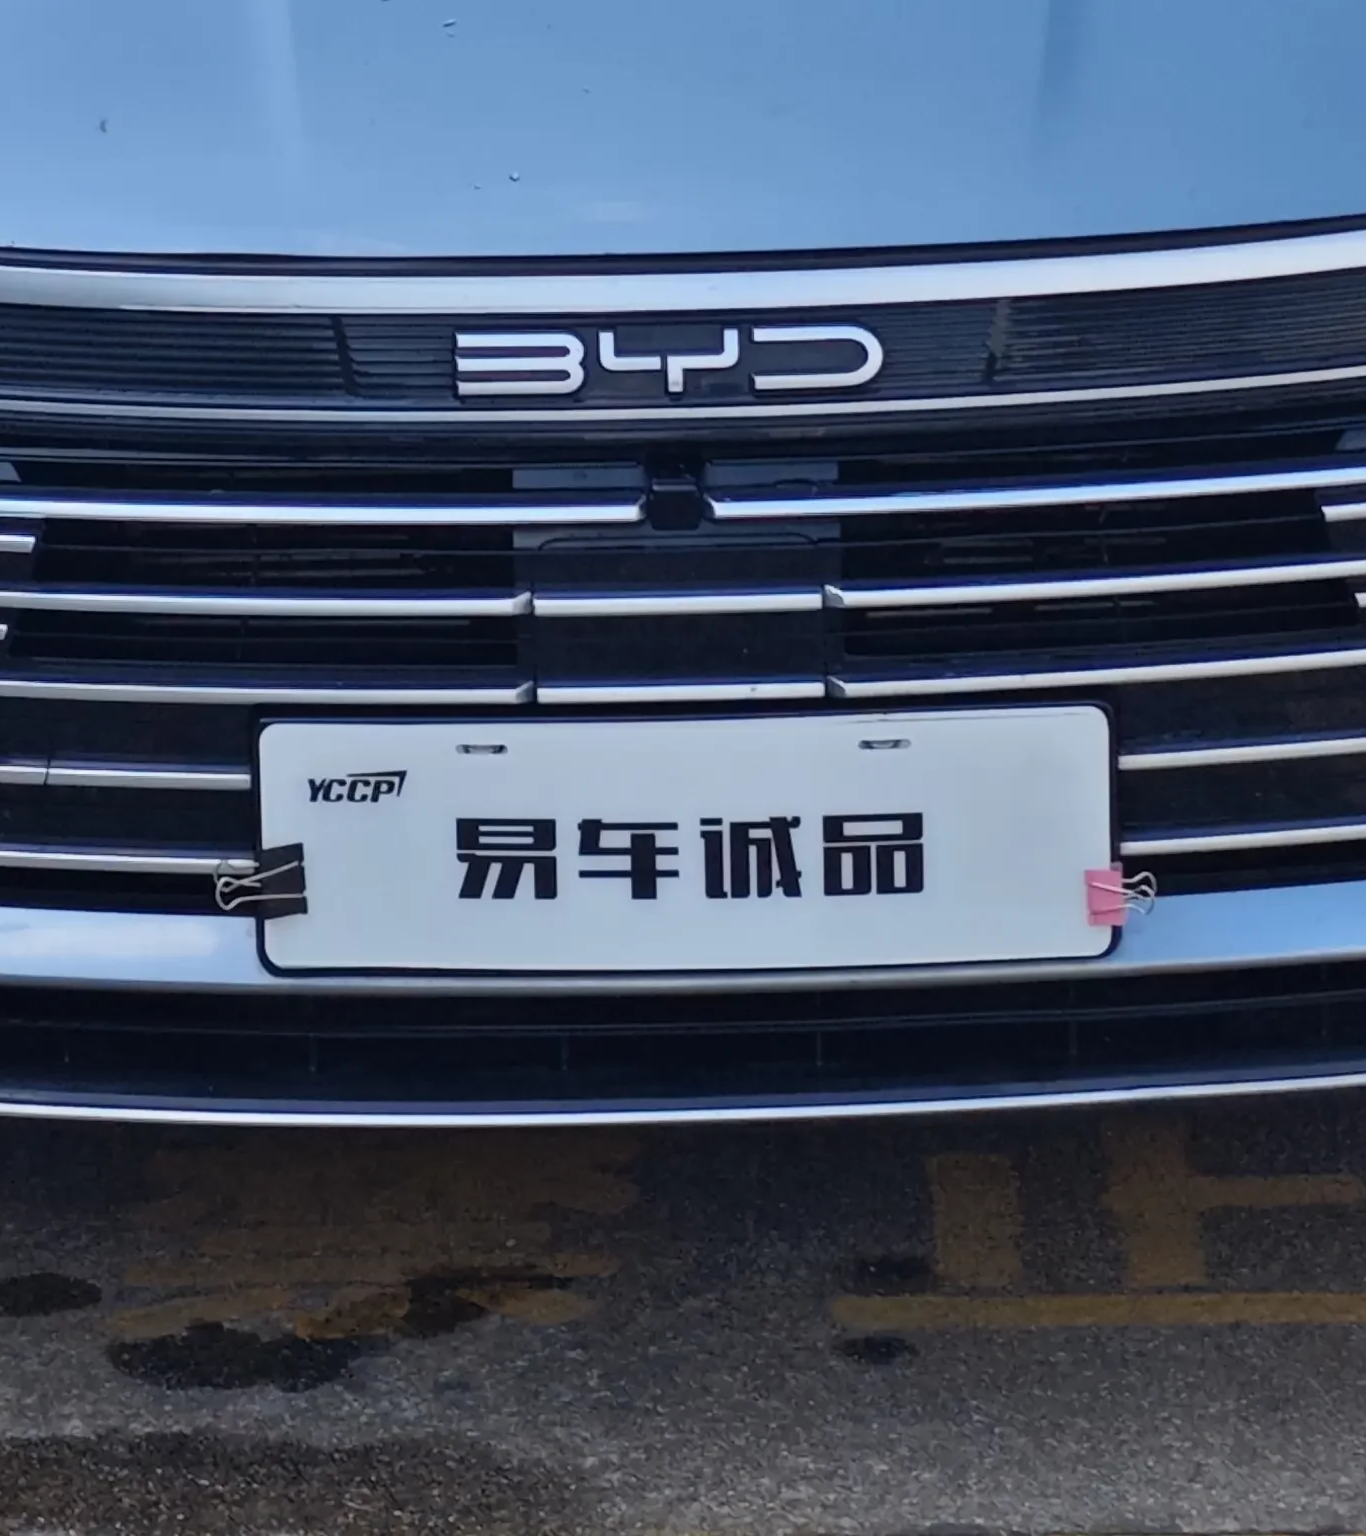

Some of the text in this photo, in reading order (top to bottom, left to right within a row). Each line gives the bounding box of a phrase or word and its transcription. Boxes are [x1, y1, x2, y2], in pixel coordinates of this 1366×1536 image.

[455, 325, 884, 396] BYD
[308, 770, 407, 803] YCCP
[455, 813, 925, 901] 易车诚品
